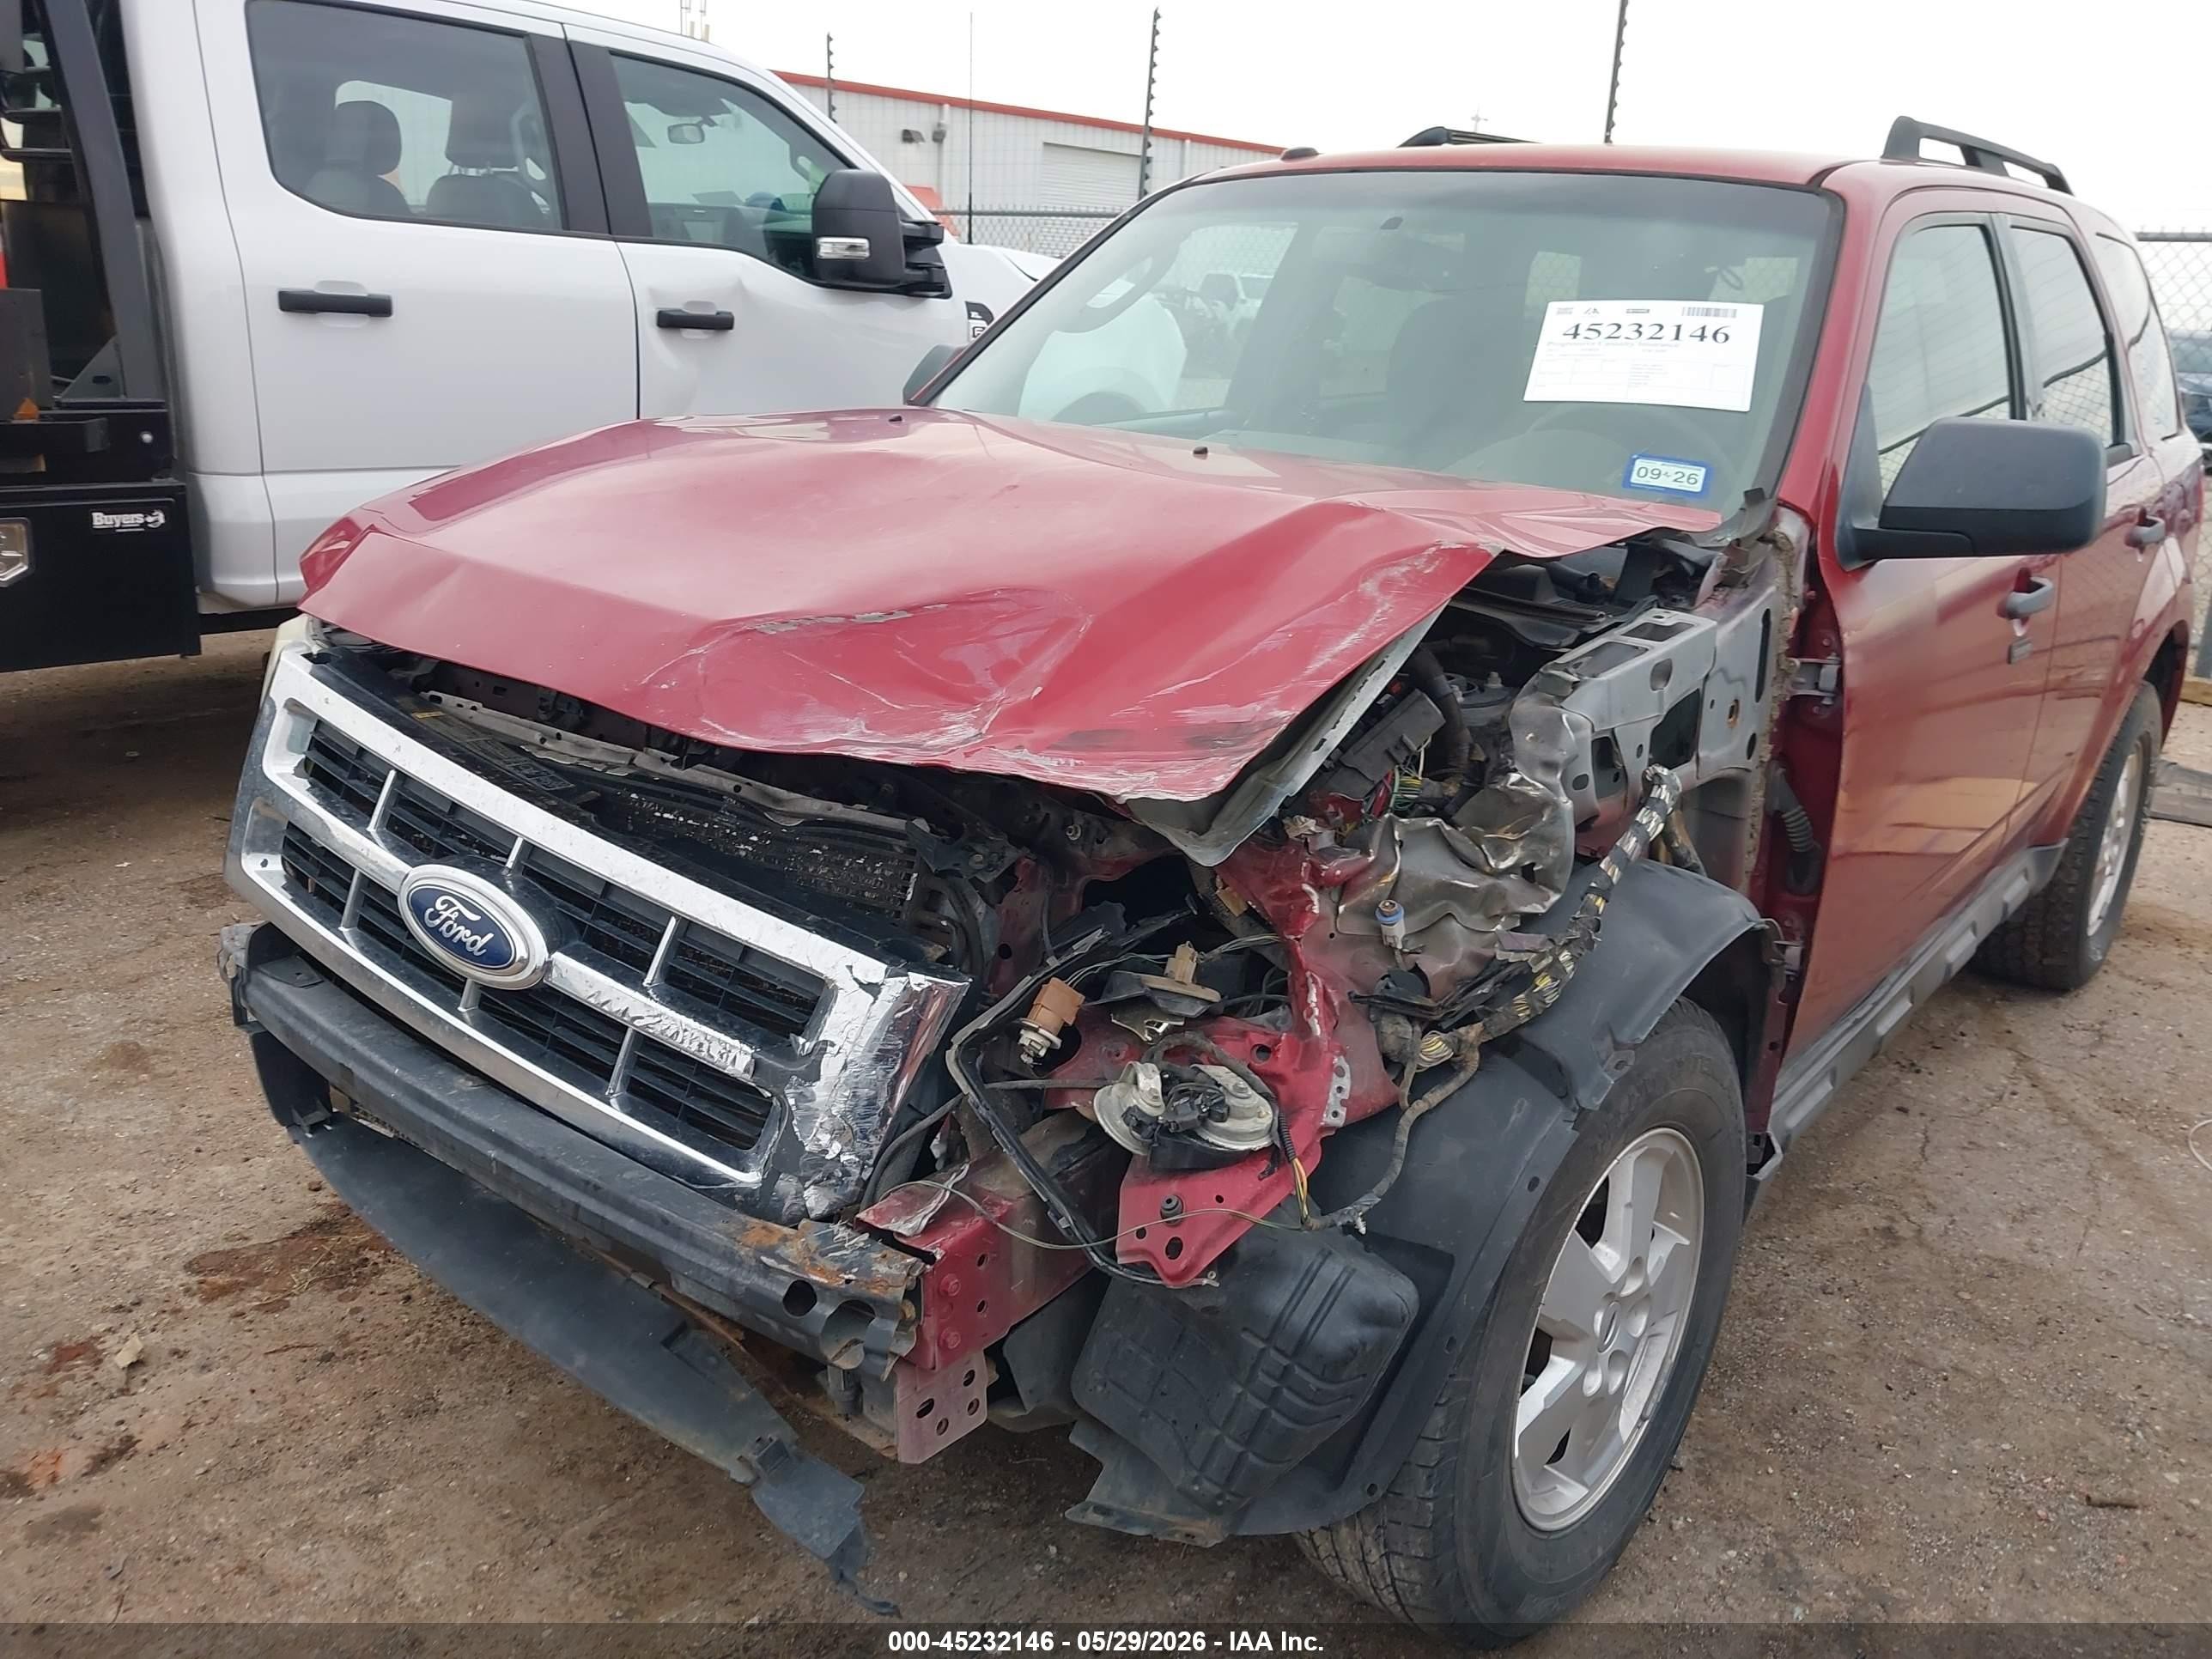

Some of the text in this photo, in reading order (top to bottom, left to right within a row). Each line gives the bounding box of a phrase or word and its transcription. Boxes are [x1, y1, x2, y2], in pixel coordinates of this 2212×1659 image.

[1562, 322, 1731, 344] 45232146
[1637, 466, 1662, 480] 09
[1673, 471, 1699, 485] 26
[92, 512, 144, 528] Buyers
[424, 896, 494, 956] Ford
